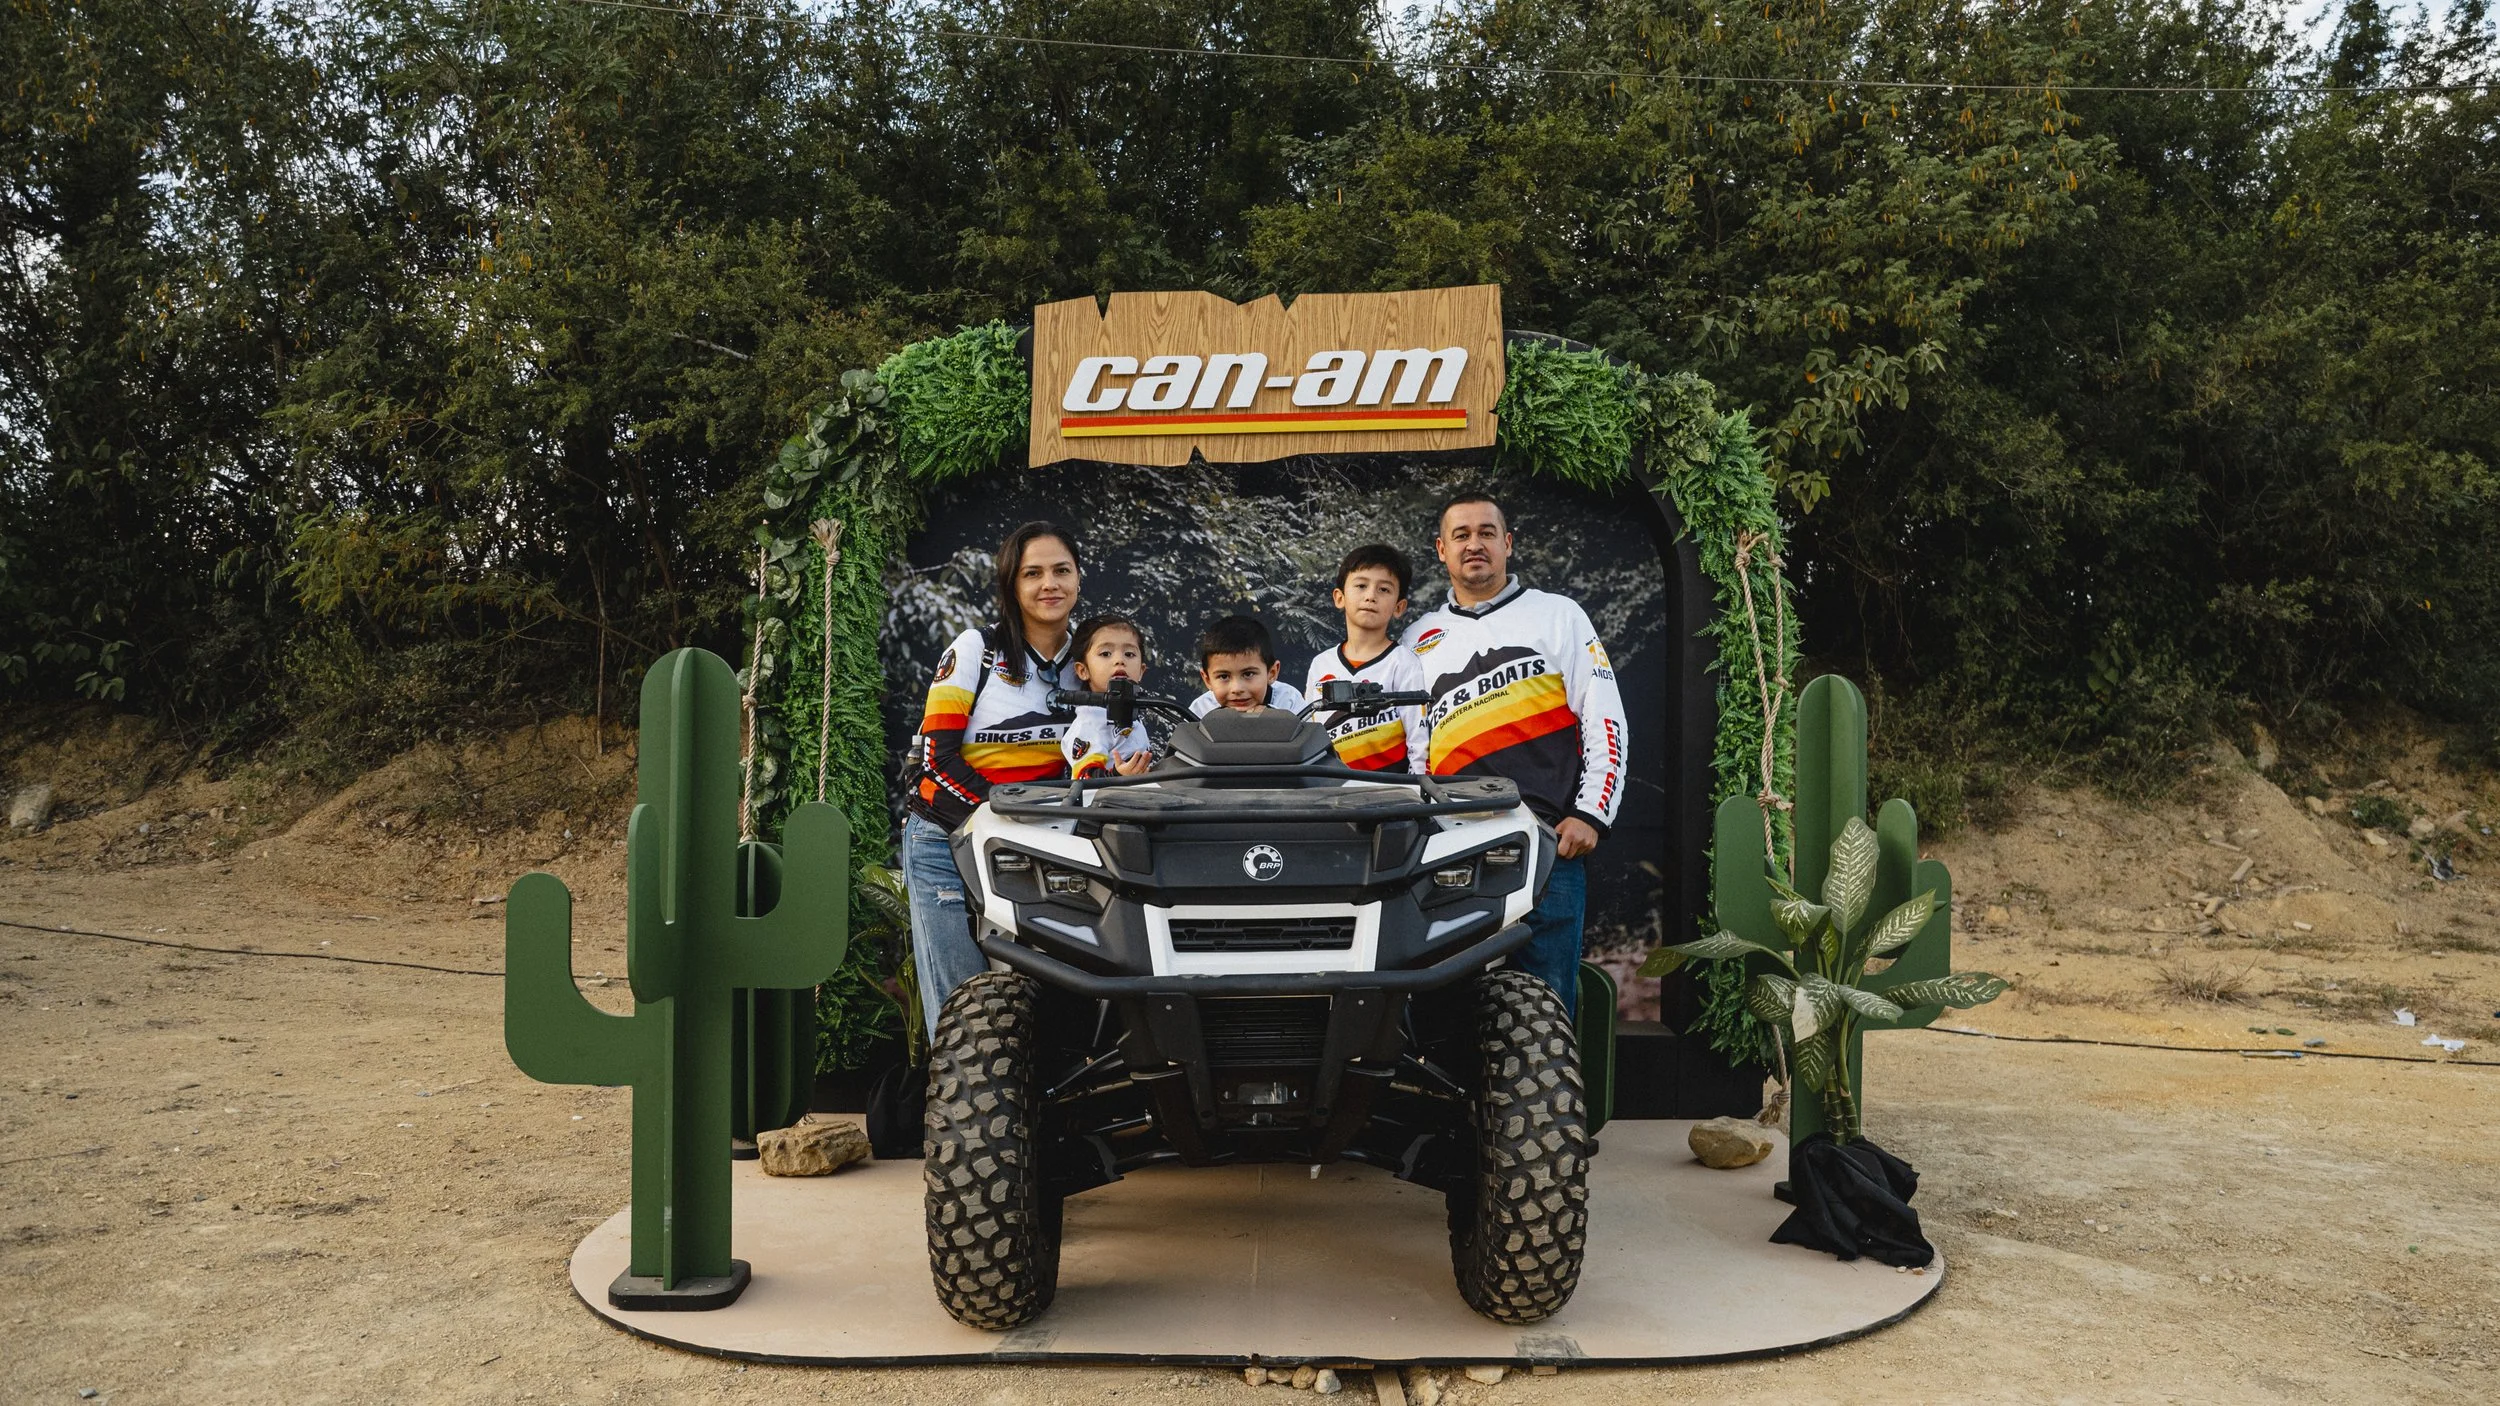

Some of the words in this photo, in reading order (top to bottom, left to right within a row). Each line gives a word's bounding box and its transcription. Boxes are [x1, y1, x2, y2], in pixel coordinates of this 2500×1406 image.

[1062, 346, 1468, 411] can-am
[1453, 688, 1470, 706] &
[1478, 659, 1545, 696] BOATS
[1592, 666, 1613, 681] AÑOS
[1440, 704, 1473, 729] CARRETERA
[1474, 689, 1510, 708] NACIONAL
[975, 730, 1032, 744] BIKES
[1039, 727, 1056, 739] &
[1341, 723, 1353, 735] &
[1018, 740, 1055, 748] CARRETERA
[1598, 718, 1621, 817] can-am
